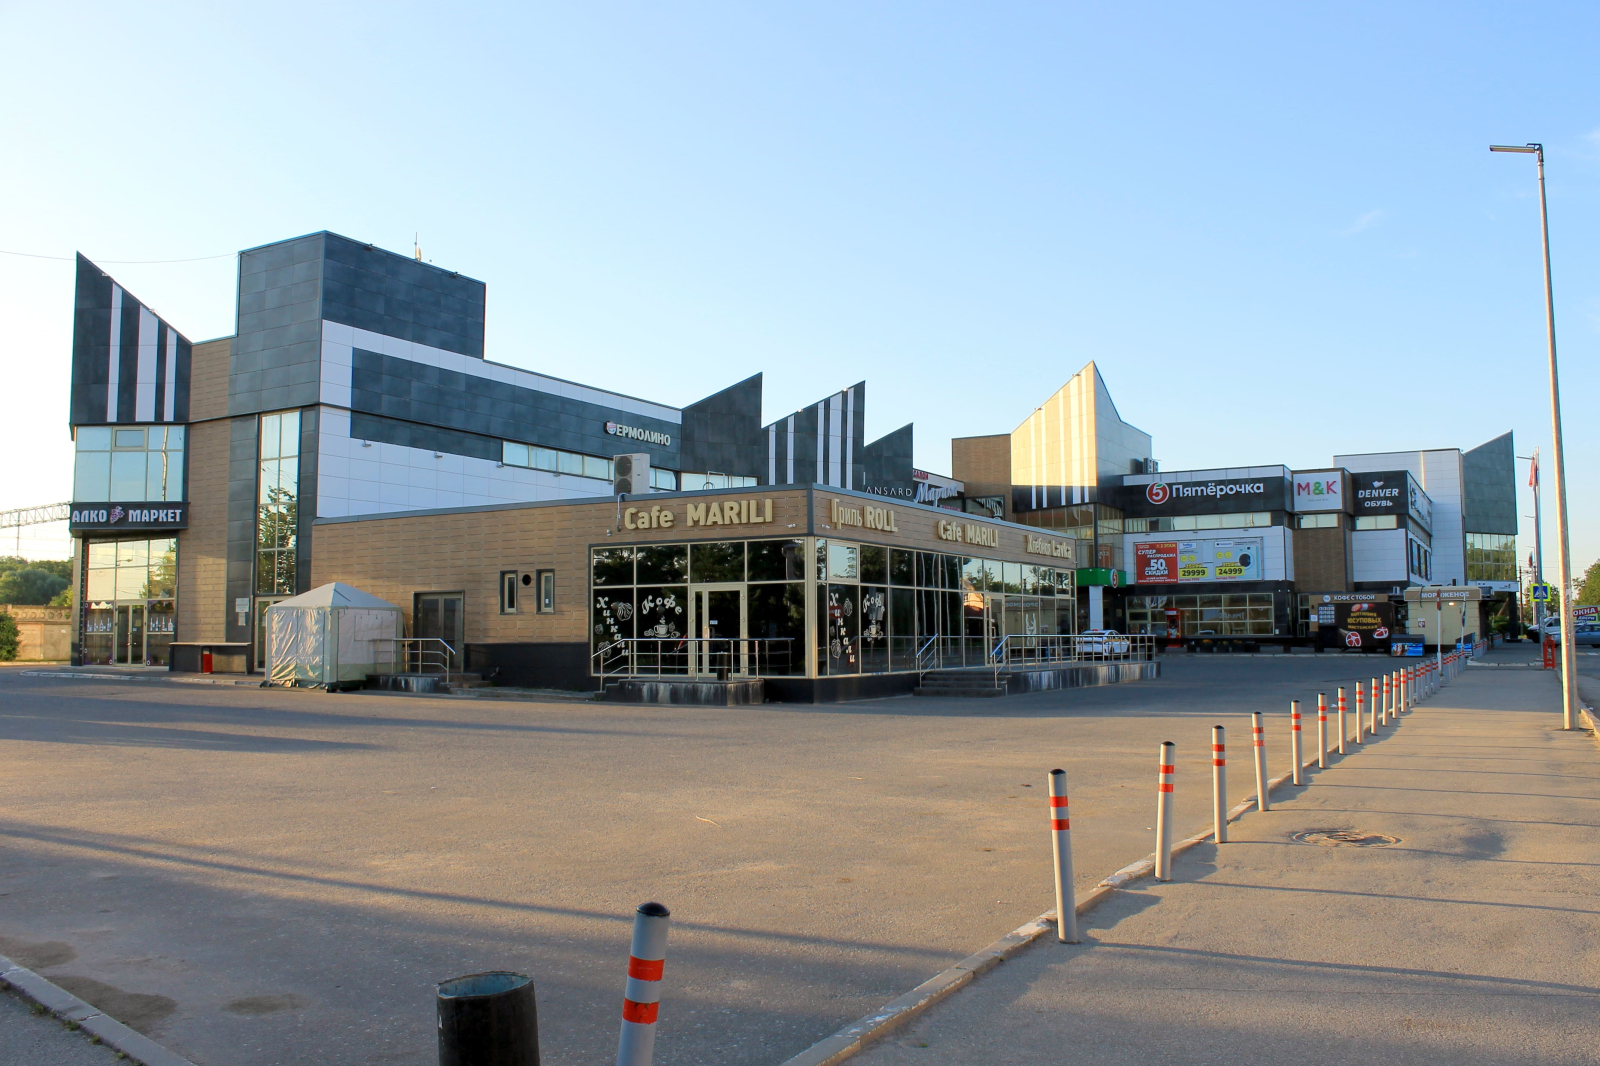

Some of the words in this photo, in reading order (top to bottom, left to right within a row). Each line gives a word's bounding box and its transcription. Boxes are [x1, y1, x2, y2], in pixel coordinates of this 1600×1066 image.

[616, 424, 671, 446] ЕРМОЛИНО
[1172, 482, 1264, 499] Пятёрочка
[1297, 480, 1337, 496] M&K
[1358, 488, 1399, 498] DENVER
[71, 509, 108, 523] АЛКО
[128, 509, 182, 523] МАРКЕТ
[624, 505, 674, 530] Cafe
[686, 498, 773, 527] MARILI
[830, 498, 862, 530] Гриль
[863, 505, 898, 532] ROLL
[937, 520, 962, 542] Cafe
[964, 524, 999, 548] MARILI
[1181, 569, 1206, 577] 29999
[1218, 567, 1242, 575] 24999
[641, 594, 683, 615] Кофе
[1573, 607, 1596, 615] ОКНА
